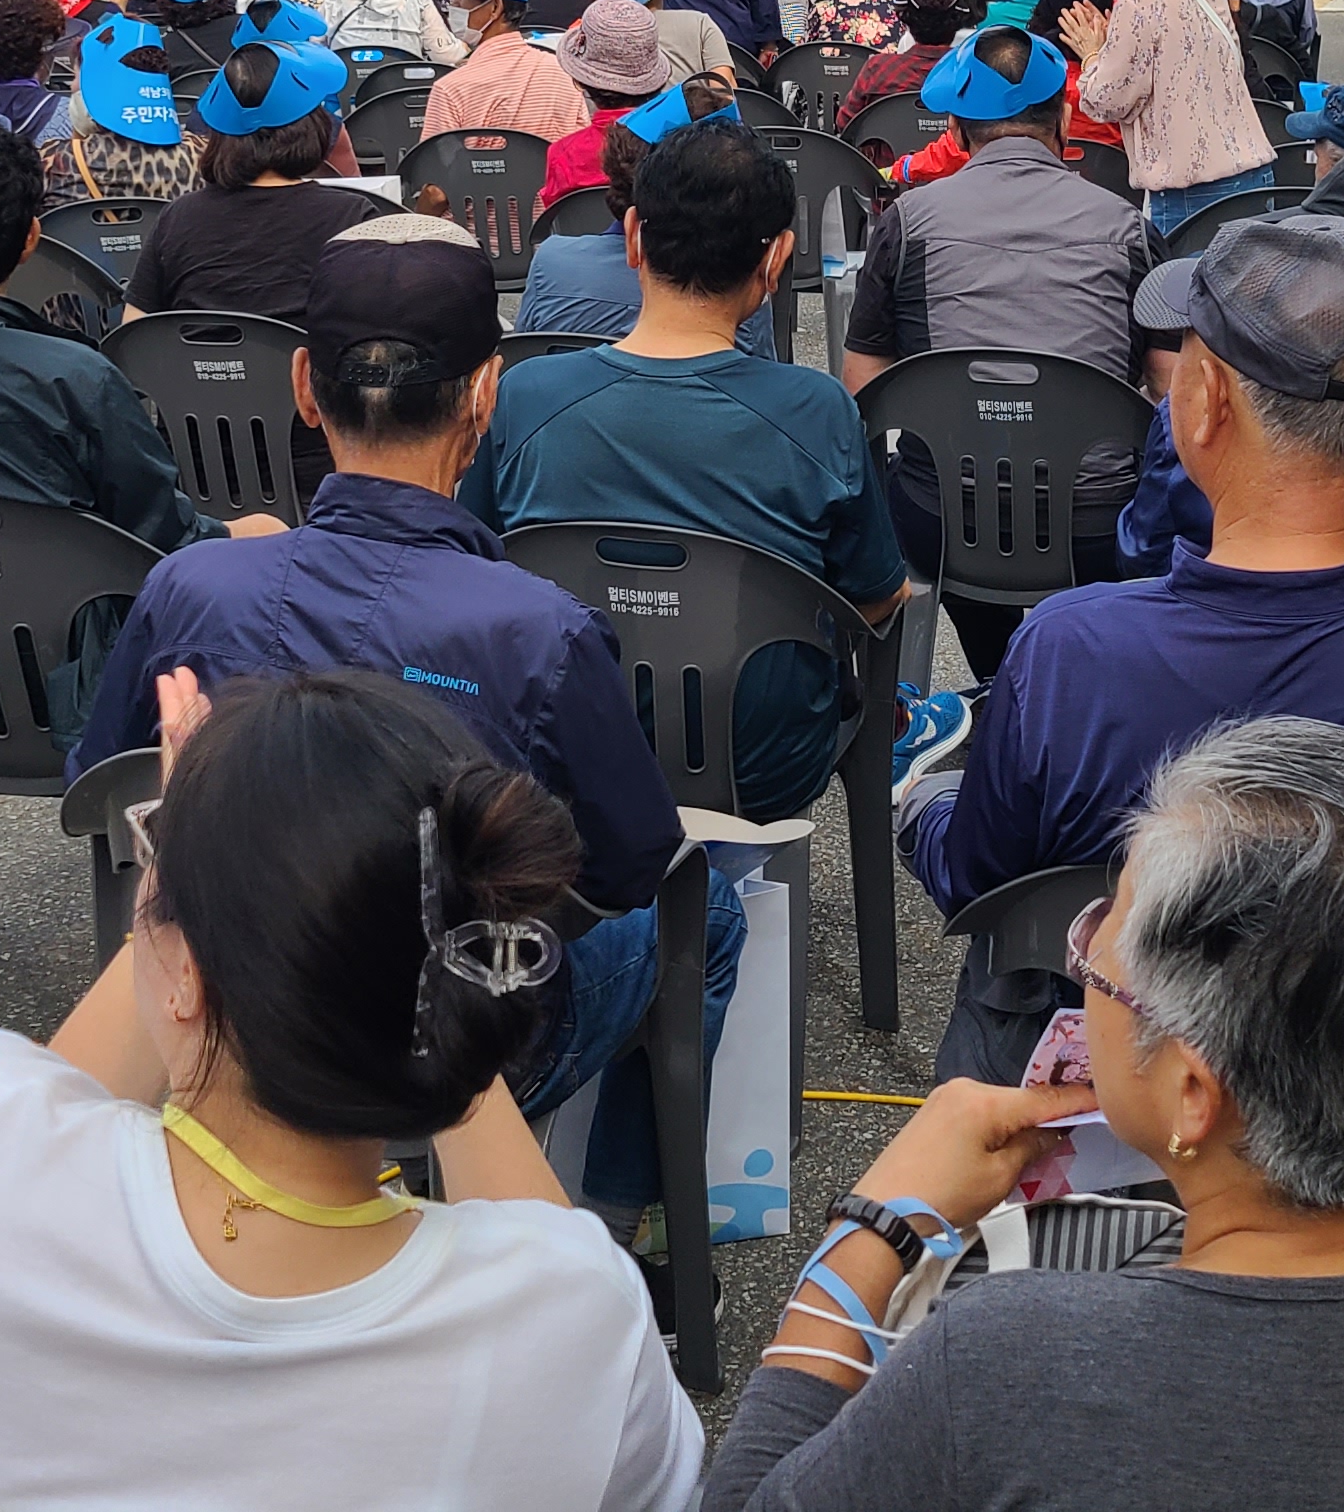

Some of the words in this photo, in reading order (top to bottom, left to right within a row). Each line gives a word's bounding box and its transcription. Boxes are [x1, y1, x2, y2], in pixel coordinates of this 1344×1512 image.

[193, 360, 245, 372] 멀티SM이벤트
[977, 400, 1033, 414] 멀티SM이벤트
[979, 414, 1033, 422] 010-4225-9916
[608, 587, 680, 606] 멀티SM이벤트
[611, 603, 680, 617] 010-4225-9916
[421, 671, 479, 695] MOUNTIA
